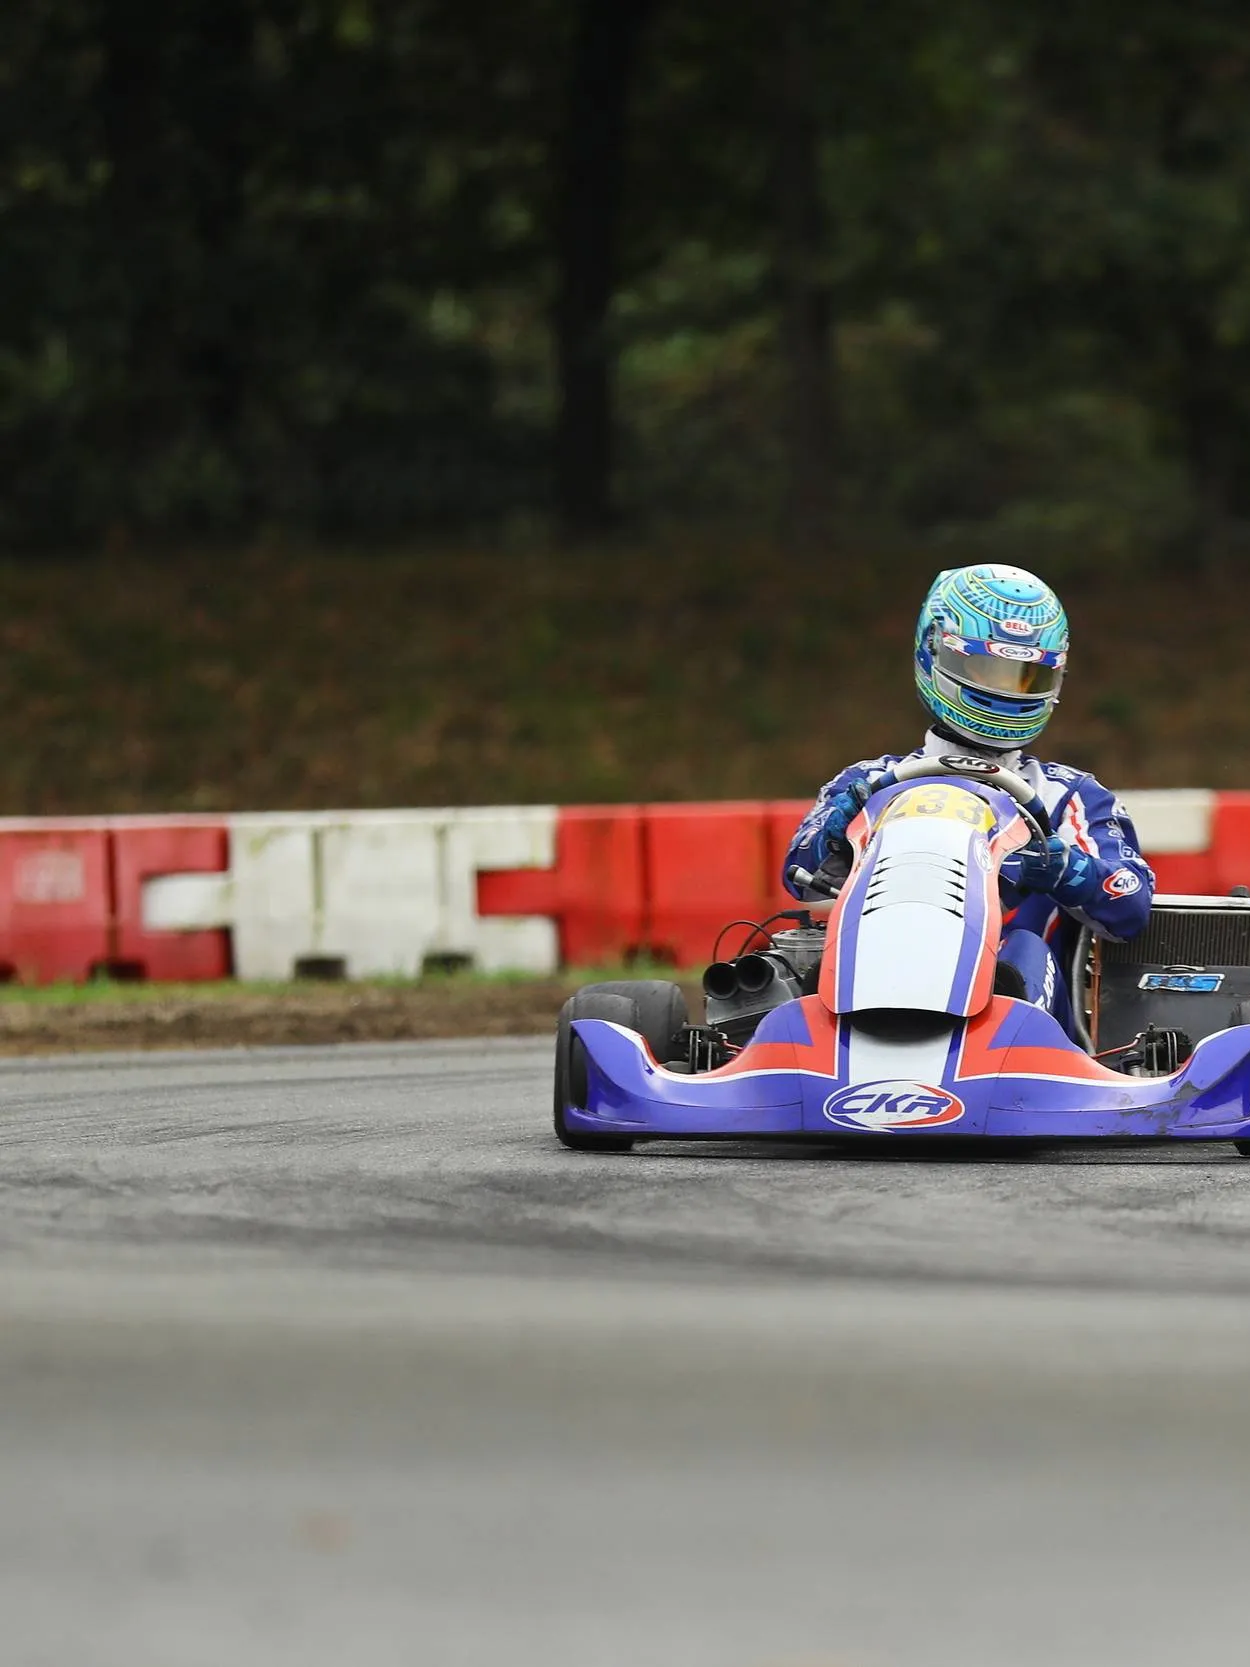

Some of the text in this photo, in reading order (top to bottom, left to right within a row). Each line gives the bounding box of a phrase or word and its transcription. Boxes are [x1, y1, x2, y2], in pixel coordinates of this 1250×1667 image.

[1005, 621, 1029, 633] BELL
[1112, 874, 1139, 890] CKR
[829, 1092, 952, 1116] CKR
